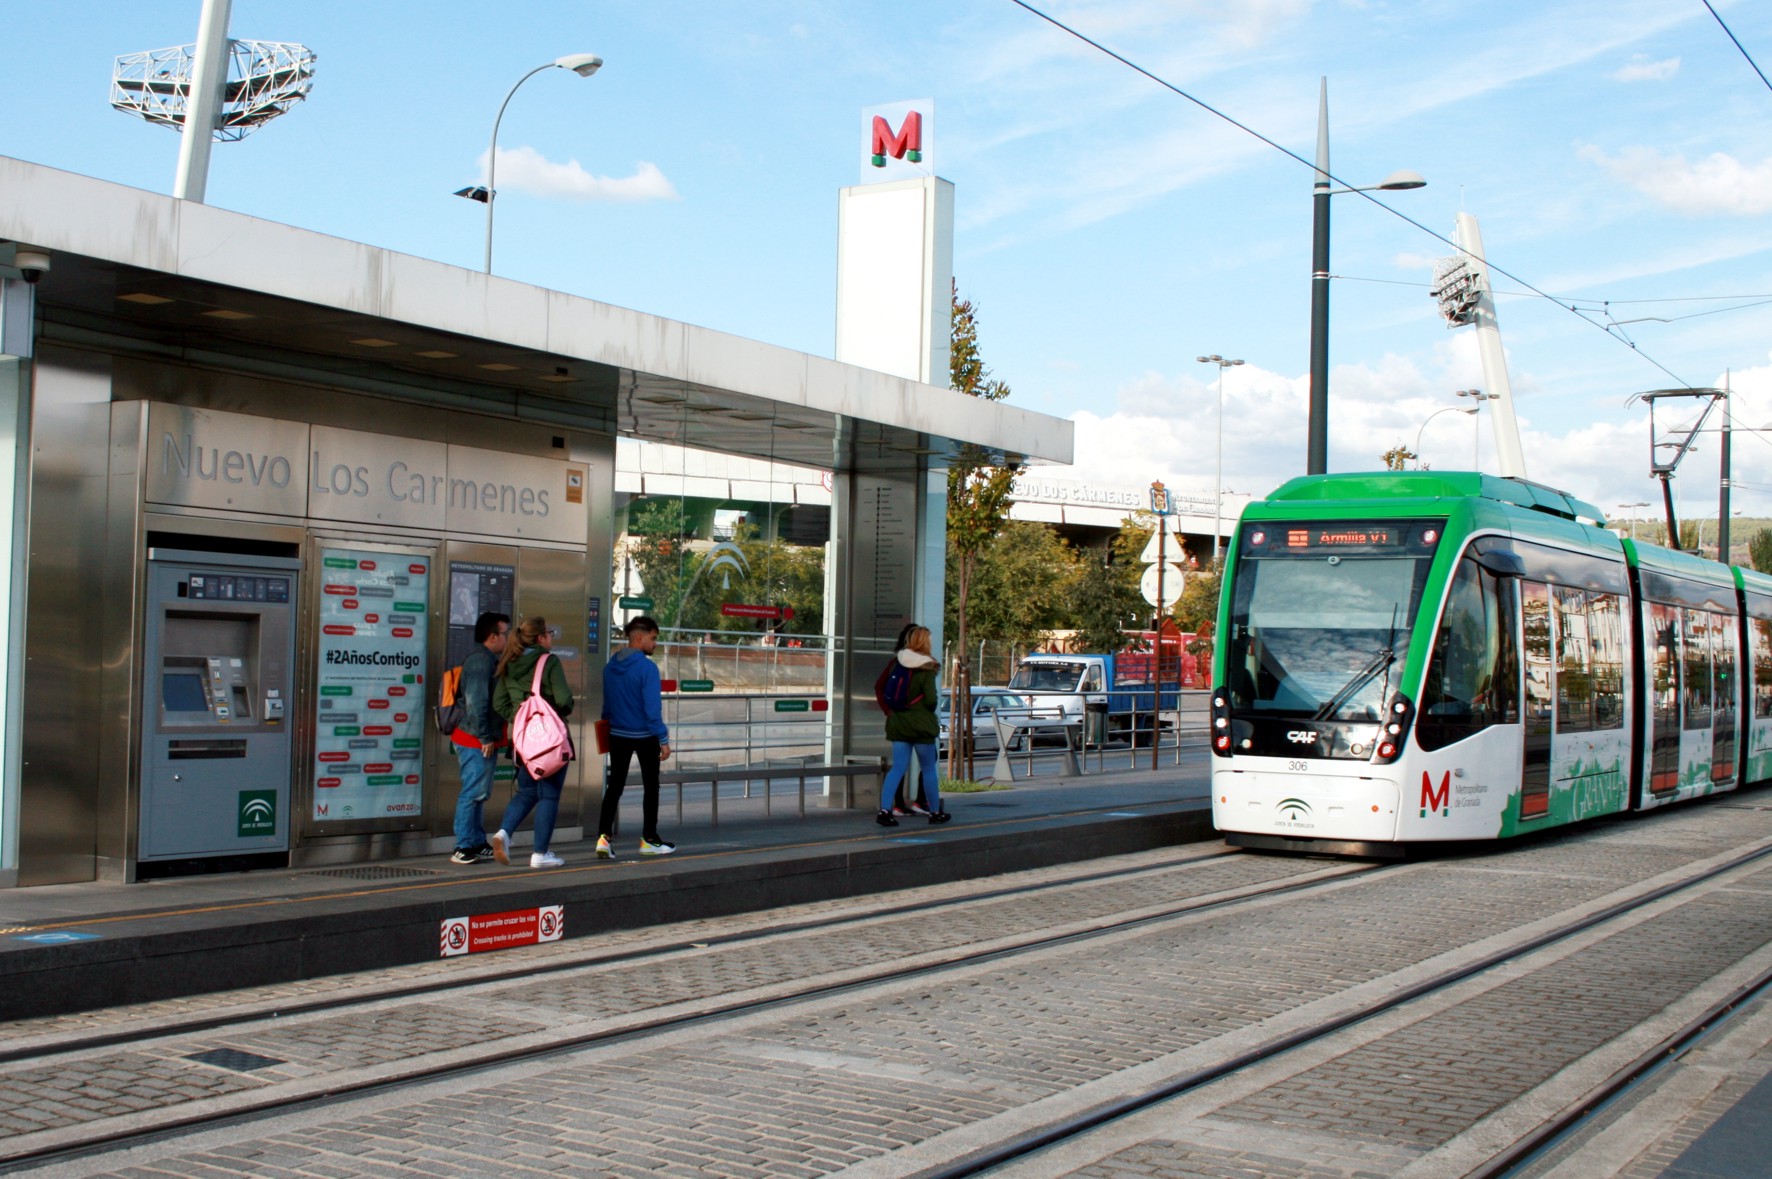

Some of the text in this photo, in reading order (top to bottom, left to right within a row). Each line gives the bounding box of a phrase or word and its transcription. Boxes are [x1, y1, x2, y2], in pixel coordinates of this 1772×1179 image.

[872, 110, 922, 168] M
[162, 432, 550, 517] Nuevo Los Carmenes
[1319, 531, 1366, 544] Armilla
[326, 650, 420, 669] #2AñosContigo
[1287, 731, 1317, 744] CAF
[1288, 760, 1308, 771] 306
[1420, 770, 1450, 818] M
[471, 921, 479, 929] No
[486, 919, 503, 928] permite
[512, 930, 534, 940] prohibited
